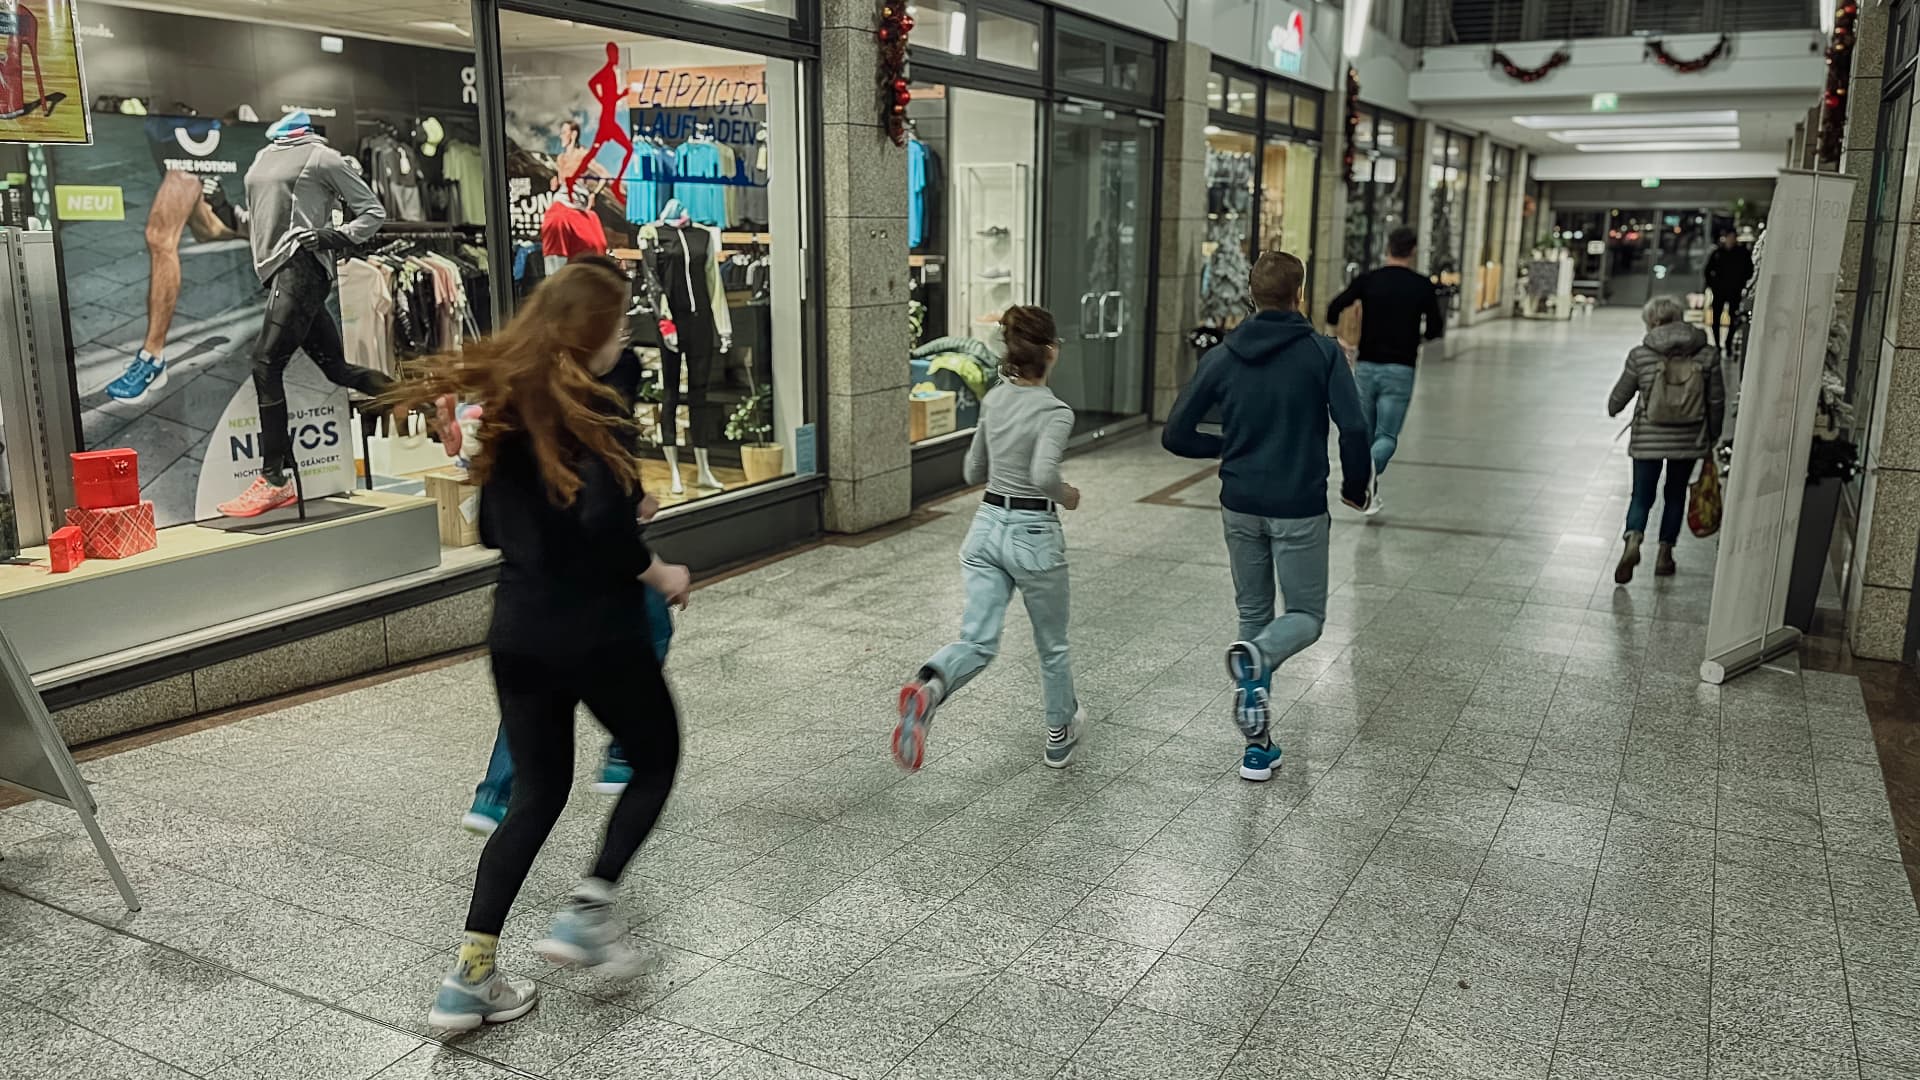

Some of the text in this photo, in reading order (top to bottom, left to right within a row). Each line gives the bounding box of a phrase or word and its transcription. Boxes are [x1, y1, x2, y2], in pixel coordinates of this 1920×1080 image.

[639, 68, 758, 118] LEIPZIGER
[638, 105, 757, 145] LAUFLADEN
[163, 159, 237, 173] TRUE MOTION
[67, 195, 114, 212] NEU!
[229, 416, 257, 428] NEXT
[296, 405, 335, 419] U-TECH
[230, 421, 339, 461] NOS
